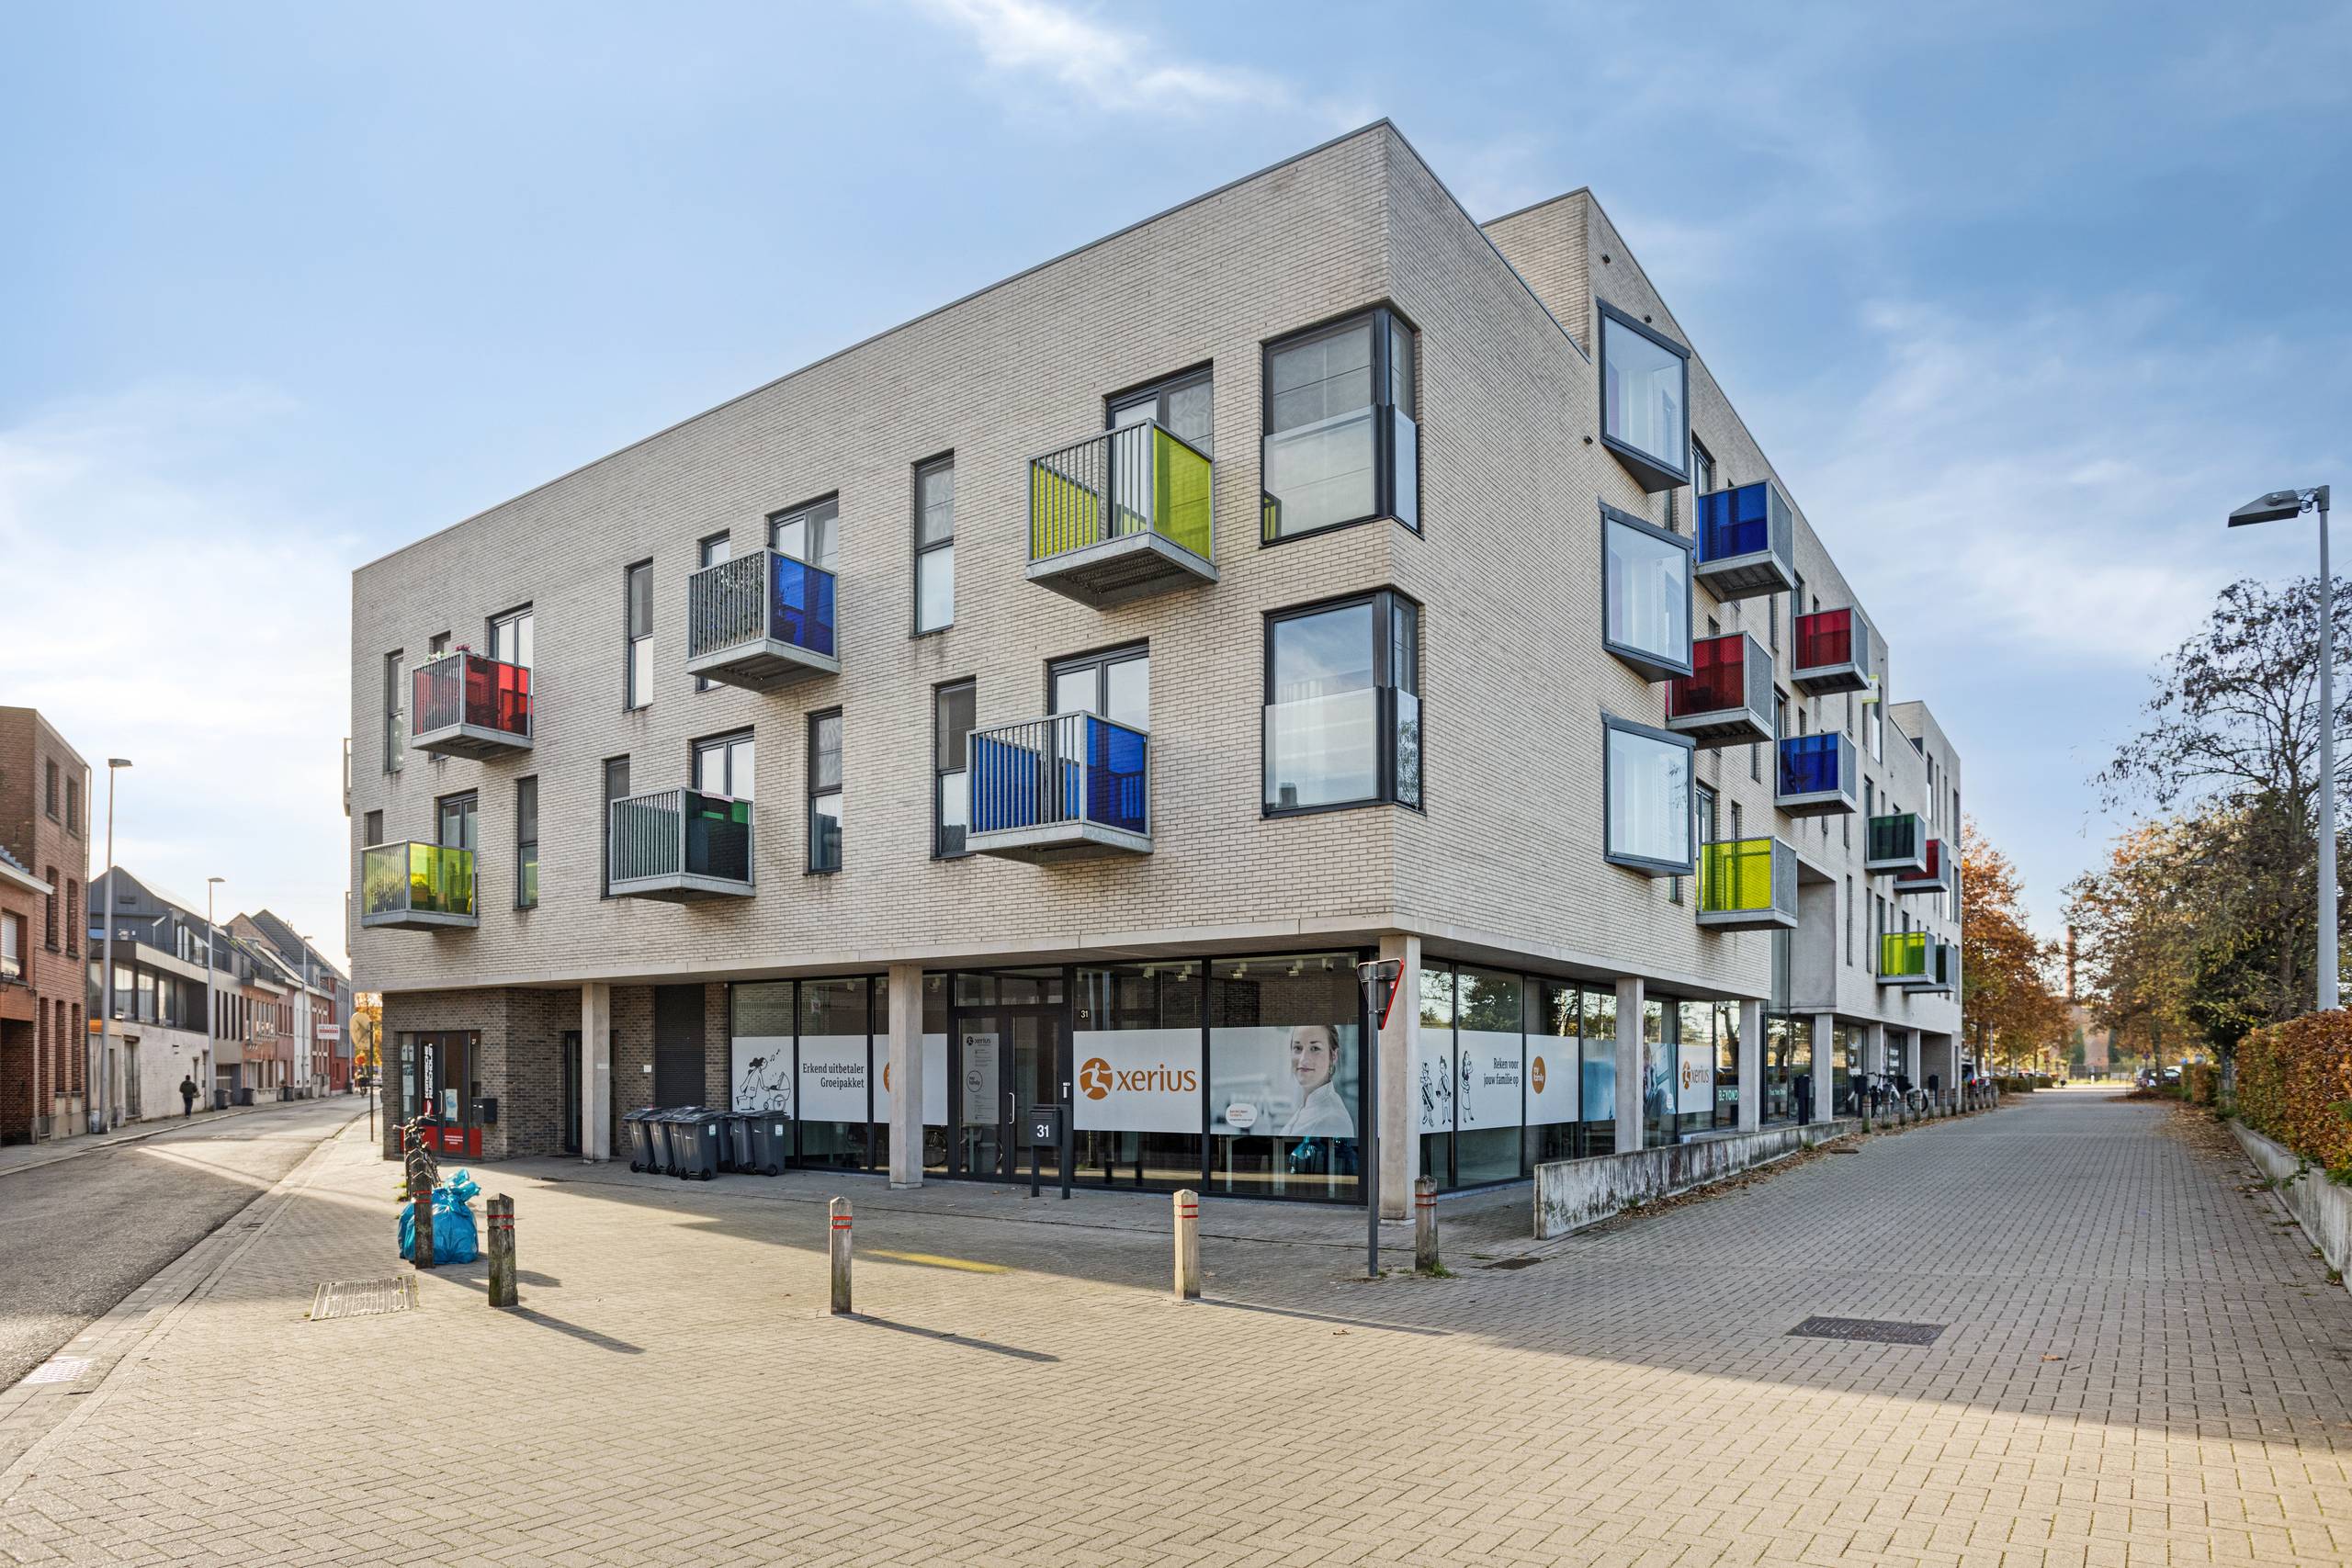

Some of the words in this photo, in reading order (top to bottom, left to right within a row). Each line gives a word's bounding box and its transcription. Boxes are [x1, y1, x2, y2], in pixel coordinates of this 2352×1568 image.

[1080, 1010, 1089, 1019] 31
[802, 1063, 827, 1074] Erkend
[828, 1063, 865, 1074] uitbetaler
[1494, 1058, 1508, 1069] Reken
[1509, 1060, 1519, 1069] voor
[1116, 1064, 1197, 1092] xerius
[1484, 1073, 1495, 1088] jouw
[1497, 1073, 1512, 1084] familie
[1513, 1077, 1519, 1087] op
[1690, 1066, 1709, 1083] xerius
[820, 1077, 865, 1090] Groeipakket
[1036, 1124, 1049, 1138] 31
